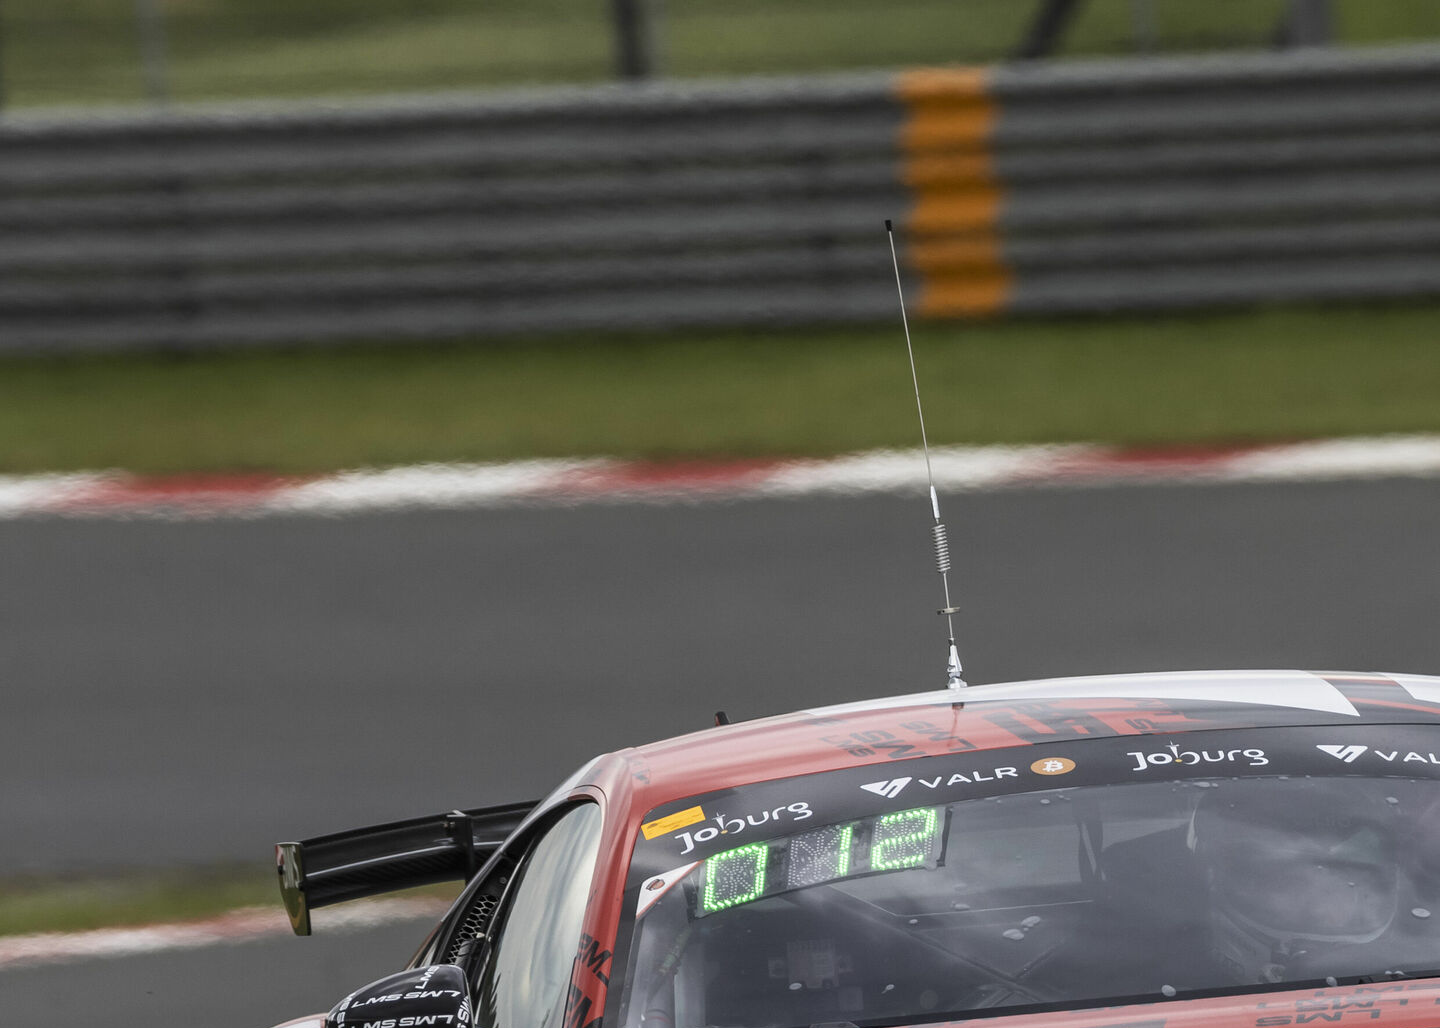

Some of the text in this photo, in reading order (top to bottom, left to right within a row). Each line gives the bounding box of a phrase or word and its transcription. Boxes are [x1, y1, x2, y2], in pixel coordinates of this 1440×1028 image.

[1126, 741, 1269, 771] Joburg
[674, 766, 1018, 855] Joburg VALR
